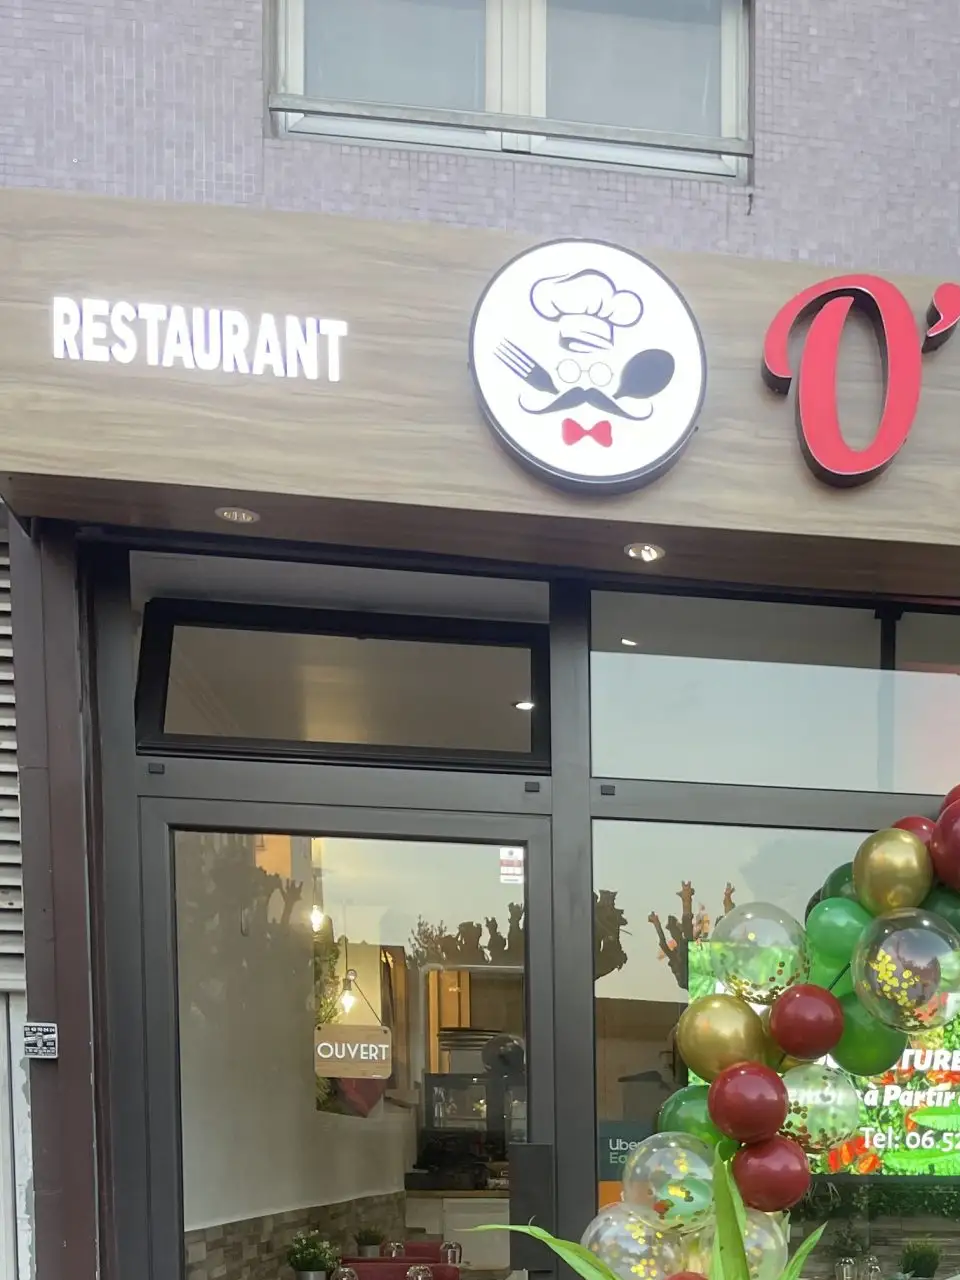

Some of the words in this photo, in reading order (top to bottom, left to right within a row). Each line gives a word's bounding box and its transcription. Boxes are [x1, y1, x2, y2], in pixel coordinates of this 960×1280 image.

[53, 296, 348, 383] RESTAURANT
[317, 1042, 389, 1060] OUVERT
[883, 1084, 956, 1108] Partir
[860, 1126, 899, 1149] Tel:
